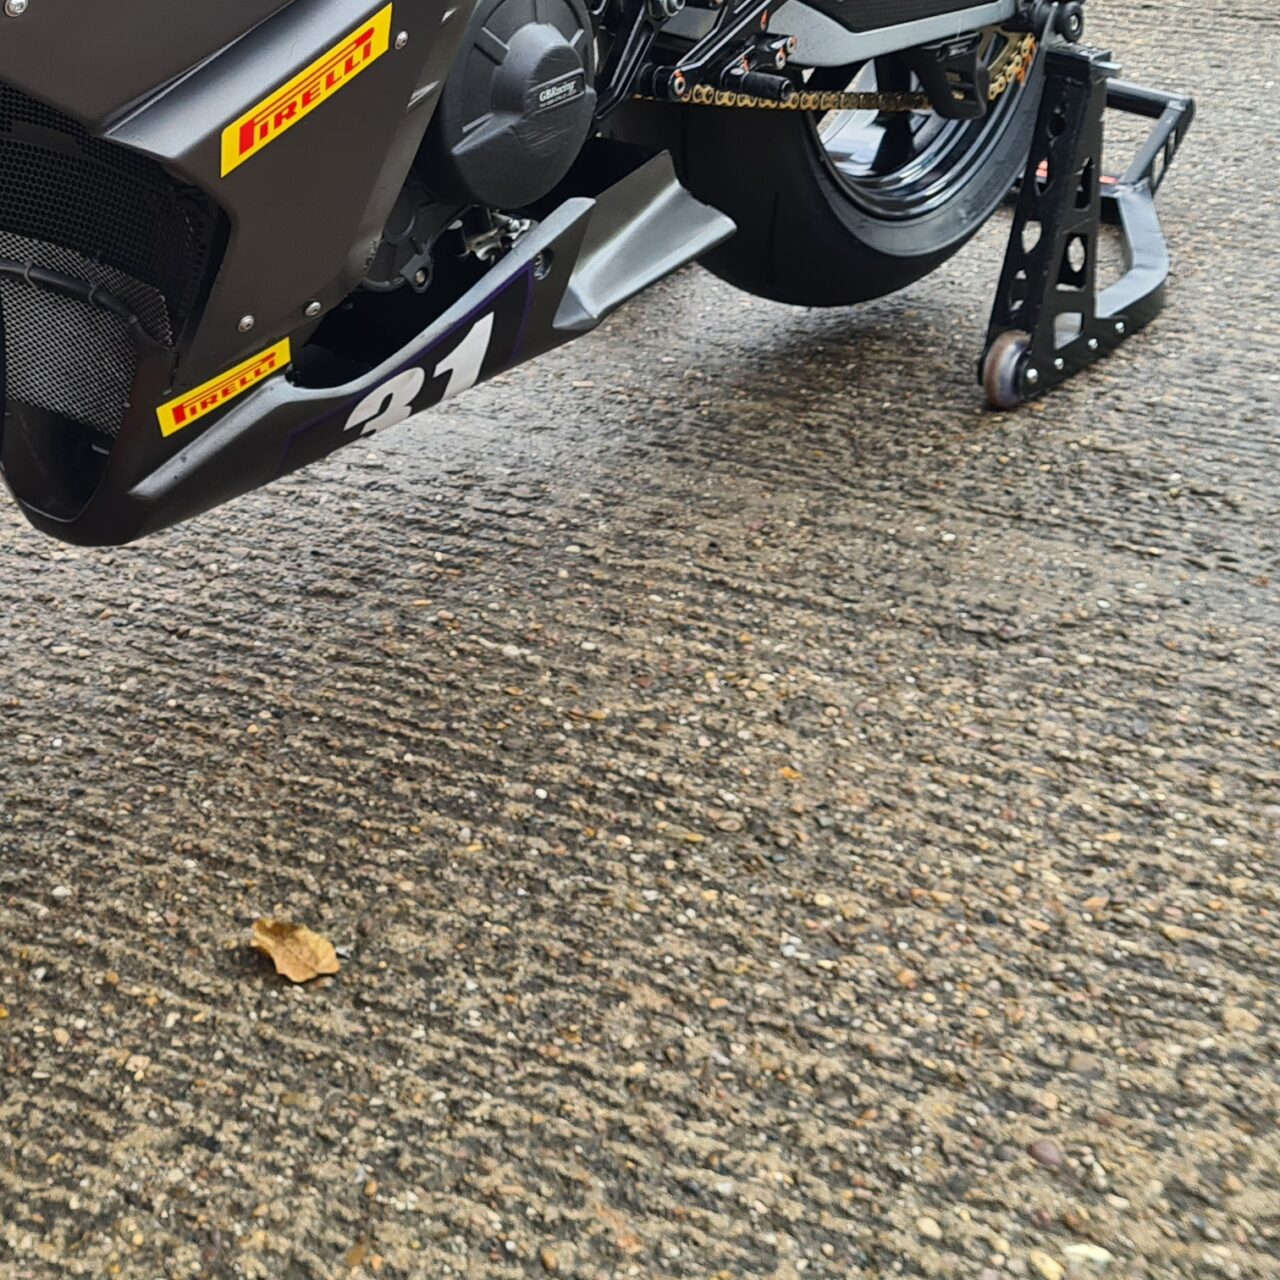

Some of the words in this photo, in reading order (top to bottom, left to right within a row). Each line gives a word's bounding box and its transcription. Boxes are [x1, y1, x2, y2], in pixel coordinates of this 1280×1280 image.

[238, 26, 376, 156] PIRELLI
[171, 351, 277, 425] PIRELLI
[342, 311, 495, 436] 31
